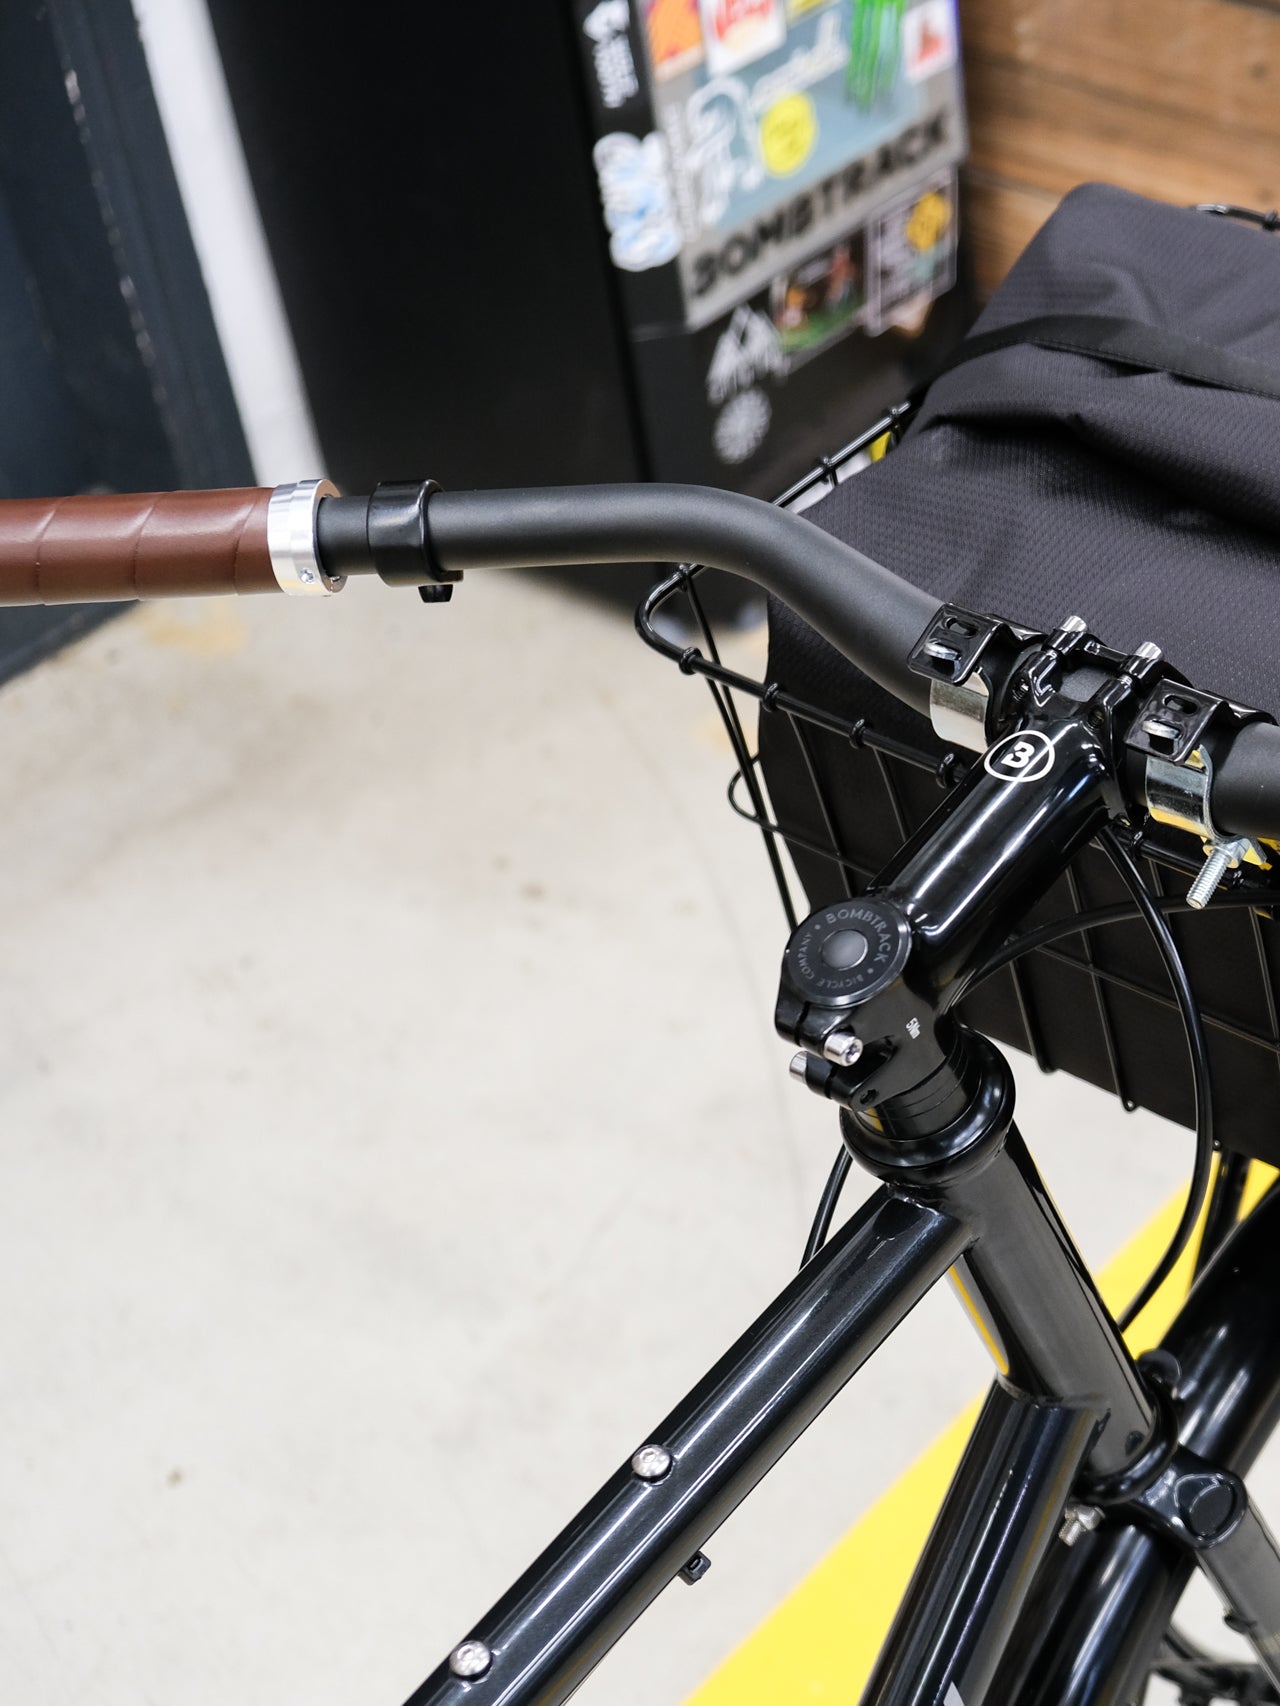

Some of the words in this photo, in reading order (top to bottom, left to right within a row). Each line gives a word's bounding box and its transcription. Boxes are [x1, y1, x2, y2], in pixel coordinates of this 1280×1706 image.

[797, 932, 815, 979] COMPANY
[826, 909, 892, 964] BOMBTRACK
[816, 974, 865, 989] BICYCLE
